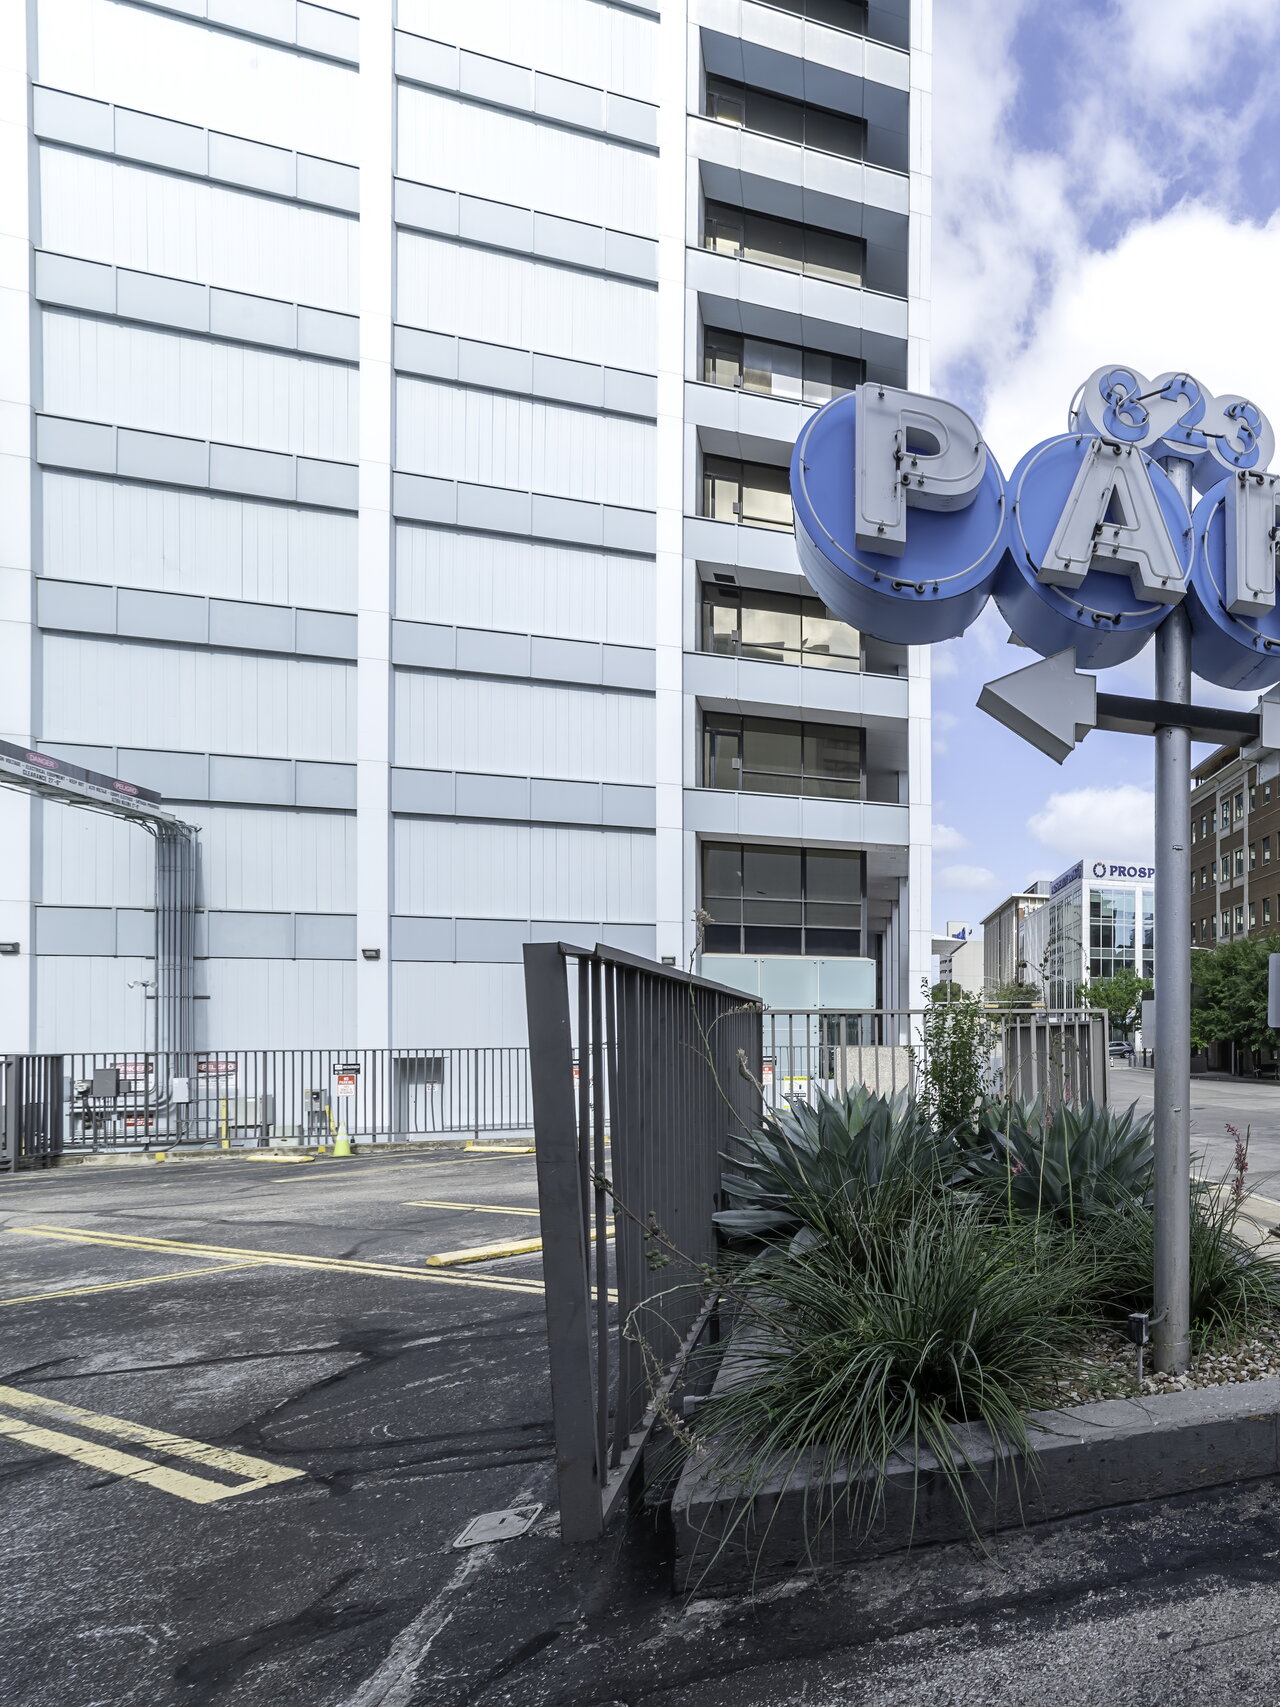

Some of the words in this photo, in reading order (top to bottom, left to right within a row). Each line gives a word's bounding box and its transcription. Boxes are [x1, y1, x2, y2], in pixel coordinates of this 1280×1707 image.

[1098, 368, 1264, 469] 823
[28, 754, 56, 768] DANGER
[22, 769, 47, 782] CLEARANCE
[115, 782, 138, 794] PELIGRO
